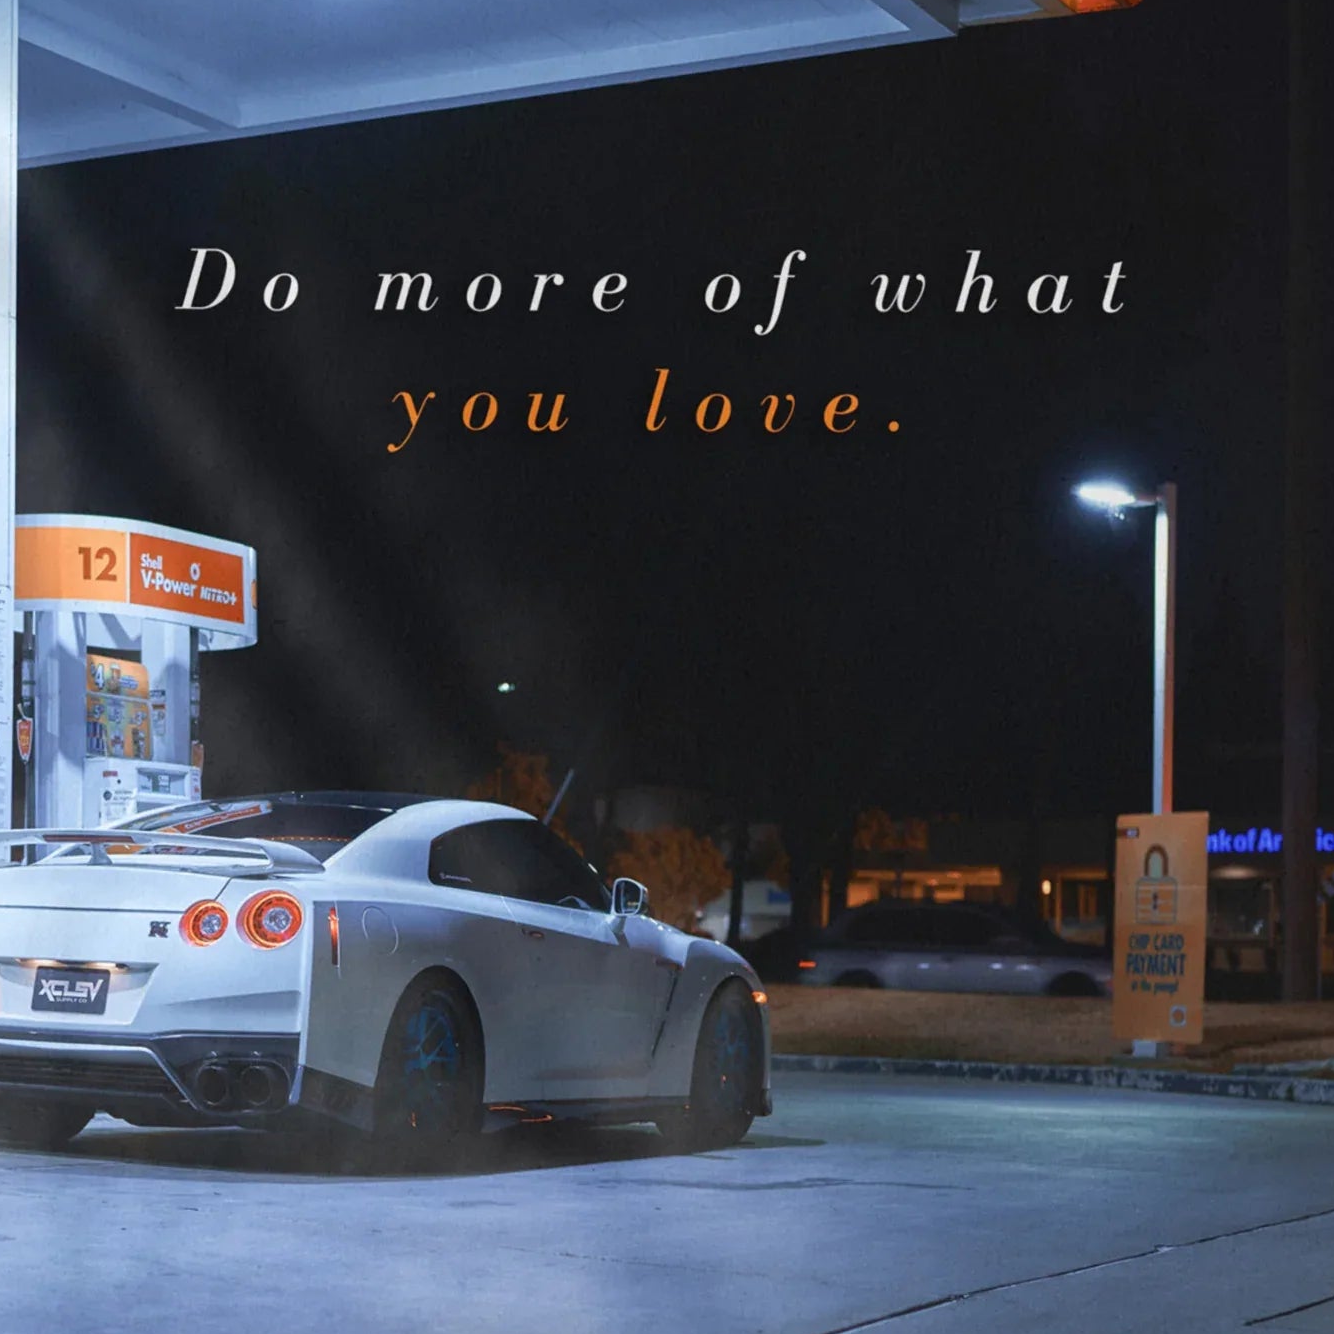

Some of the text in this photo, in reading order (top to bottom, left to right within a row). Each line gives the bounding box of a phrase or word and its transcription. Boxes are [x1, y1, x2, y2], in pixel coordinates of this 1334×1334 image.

[175, 248, 1125, 335] Do more of what
[387, 369, 899, 452] you love.
[78, 547, 117, 581] 12
[140, 553, 163, 570] Shell
[141, 568, 197, 597] V-Power
[1126, 954, 1185, 976] PAYMENT
[38, 979, 104, 1002] XCLSV
